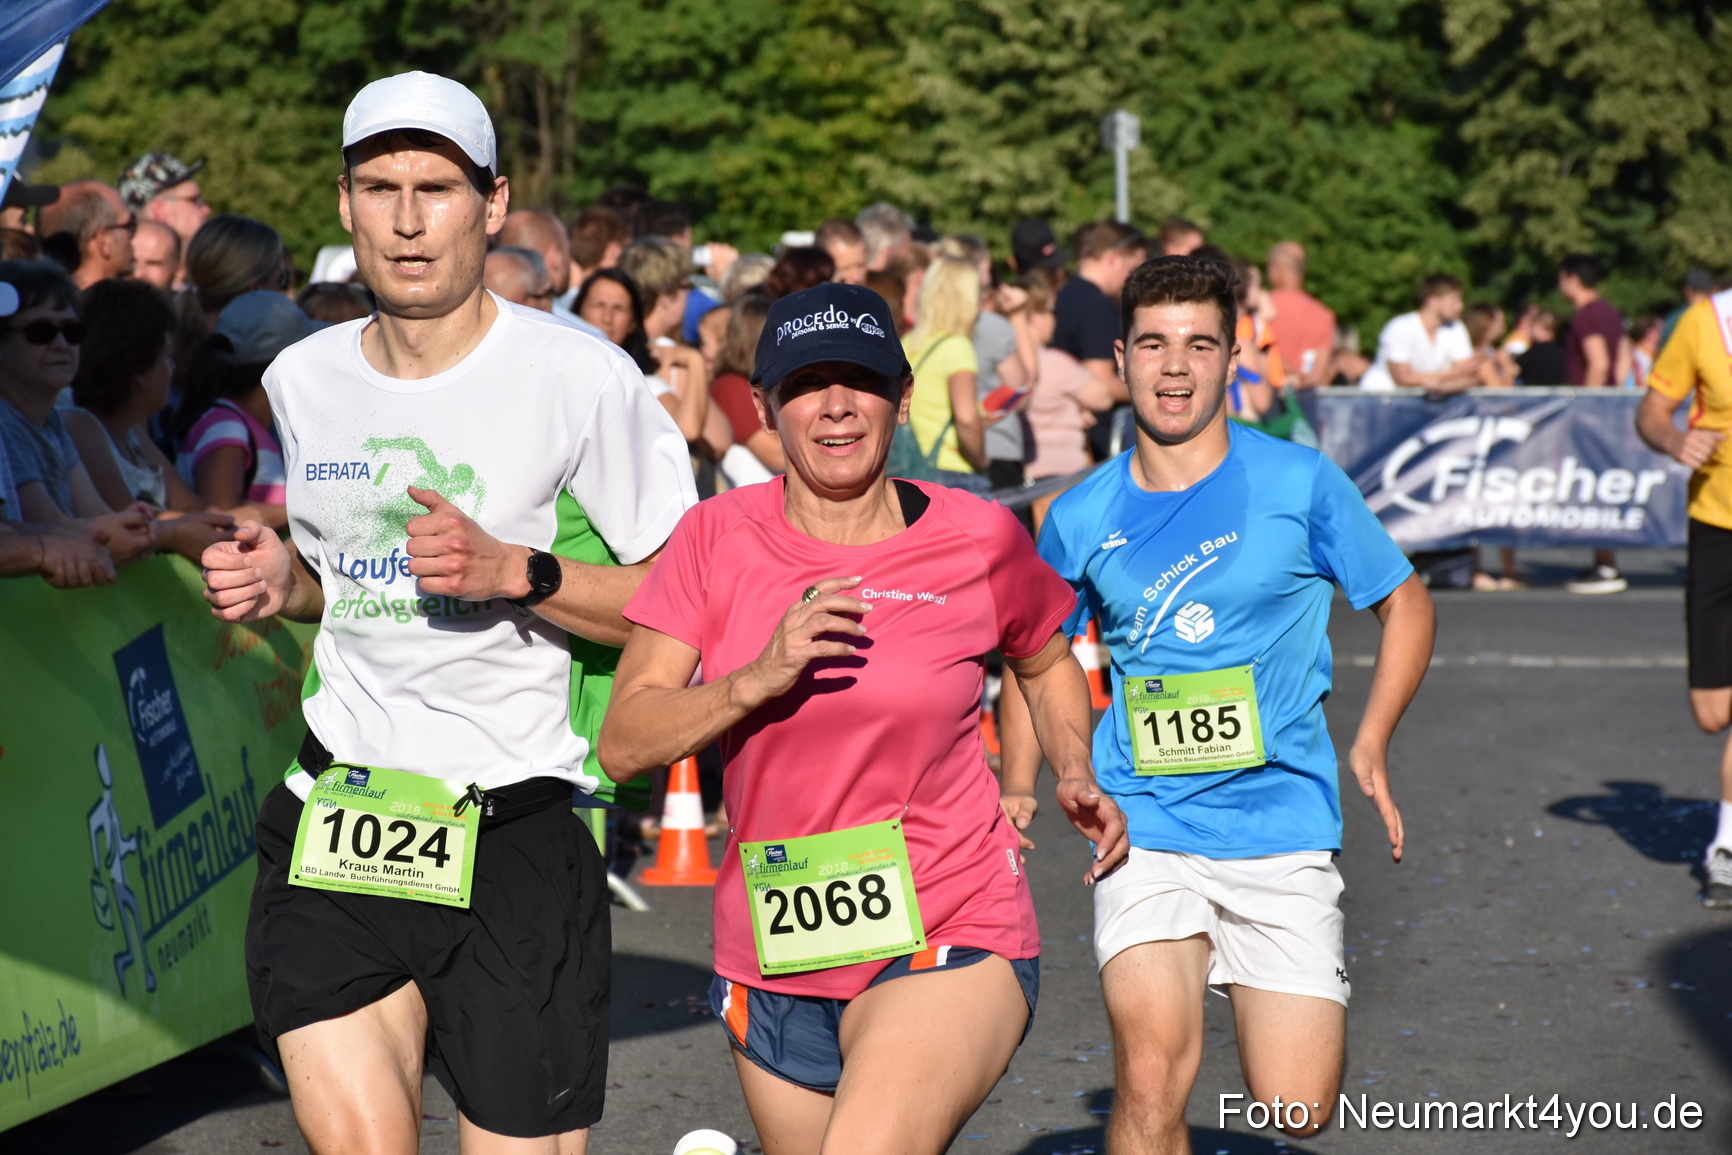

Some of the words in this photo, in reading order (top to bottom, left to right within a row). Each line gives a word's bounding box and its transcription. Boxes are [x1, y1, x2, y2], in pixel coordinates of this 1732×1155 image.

[306, 462, 370, 481] BERATA
[1430, 455, 1667, 504] Fischer
[1455, 504, 1646, 530] AUTOMOBILE
[1101, 537, 1128, 550] erima
[1143, 553, 1199, 602] Schick
[1200, 531, 1238, 556] Bau
[862, 588, 913, 601] Christine
[1139, 690, 1180, 701] firmenlauf
[1143, 705, 1241, 746] 1185
[1158, 747, 1195, 757] Schmitt
[1198, 744, 1232, 754] Fabian
[1184, 753, 1234, 763] Bauunternehmen
[1236, 750, 1256, 758] GmbH
[332, 780, 387, 799] firmenlauf
[390, 801, 421, 816] 2018
[323, 808, 450, 868] 1024
[339, 859, 378, 874] Kraus
[382, 864, 424, 879] Martin
[759, 857, 809, 874] firmenlauf
[818, 861, 848, 876] 2018
[300, 865, 317, 875] LBD
[319, 868, 348, 879] Landw.
[350, 873, 433, 890] Buchführungsdienst
[435, 883, 460, 894] GmbH
[764, 873, 891, 935] 2068
[157, 900, 212, 976] neumarkt
